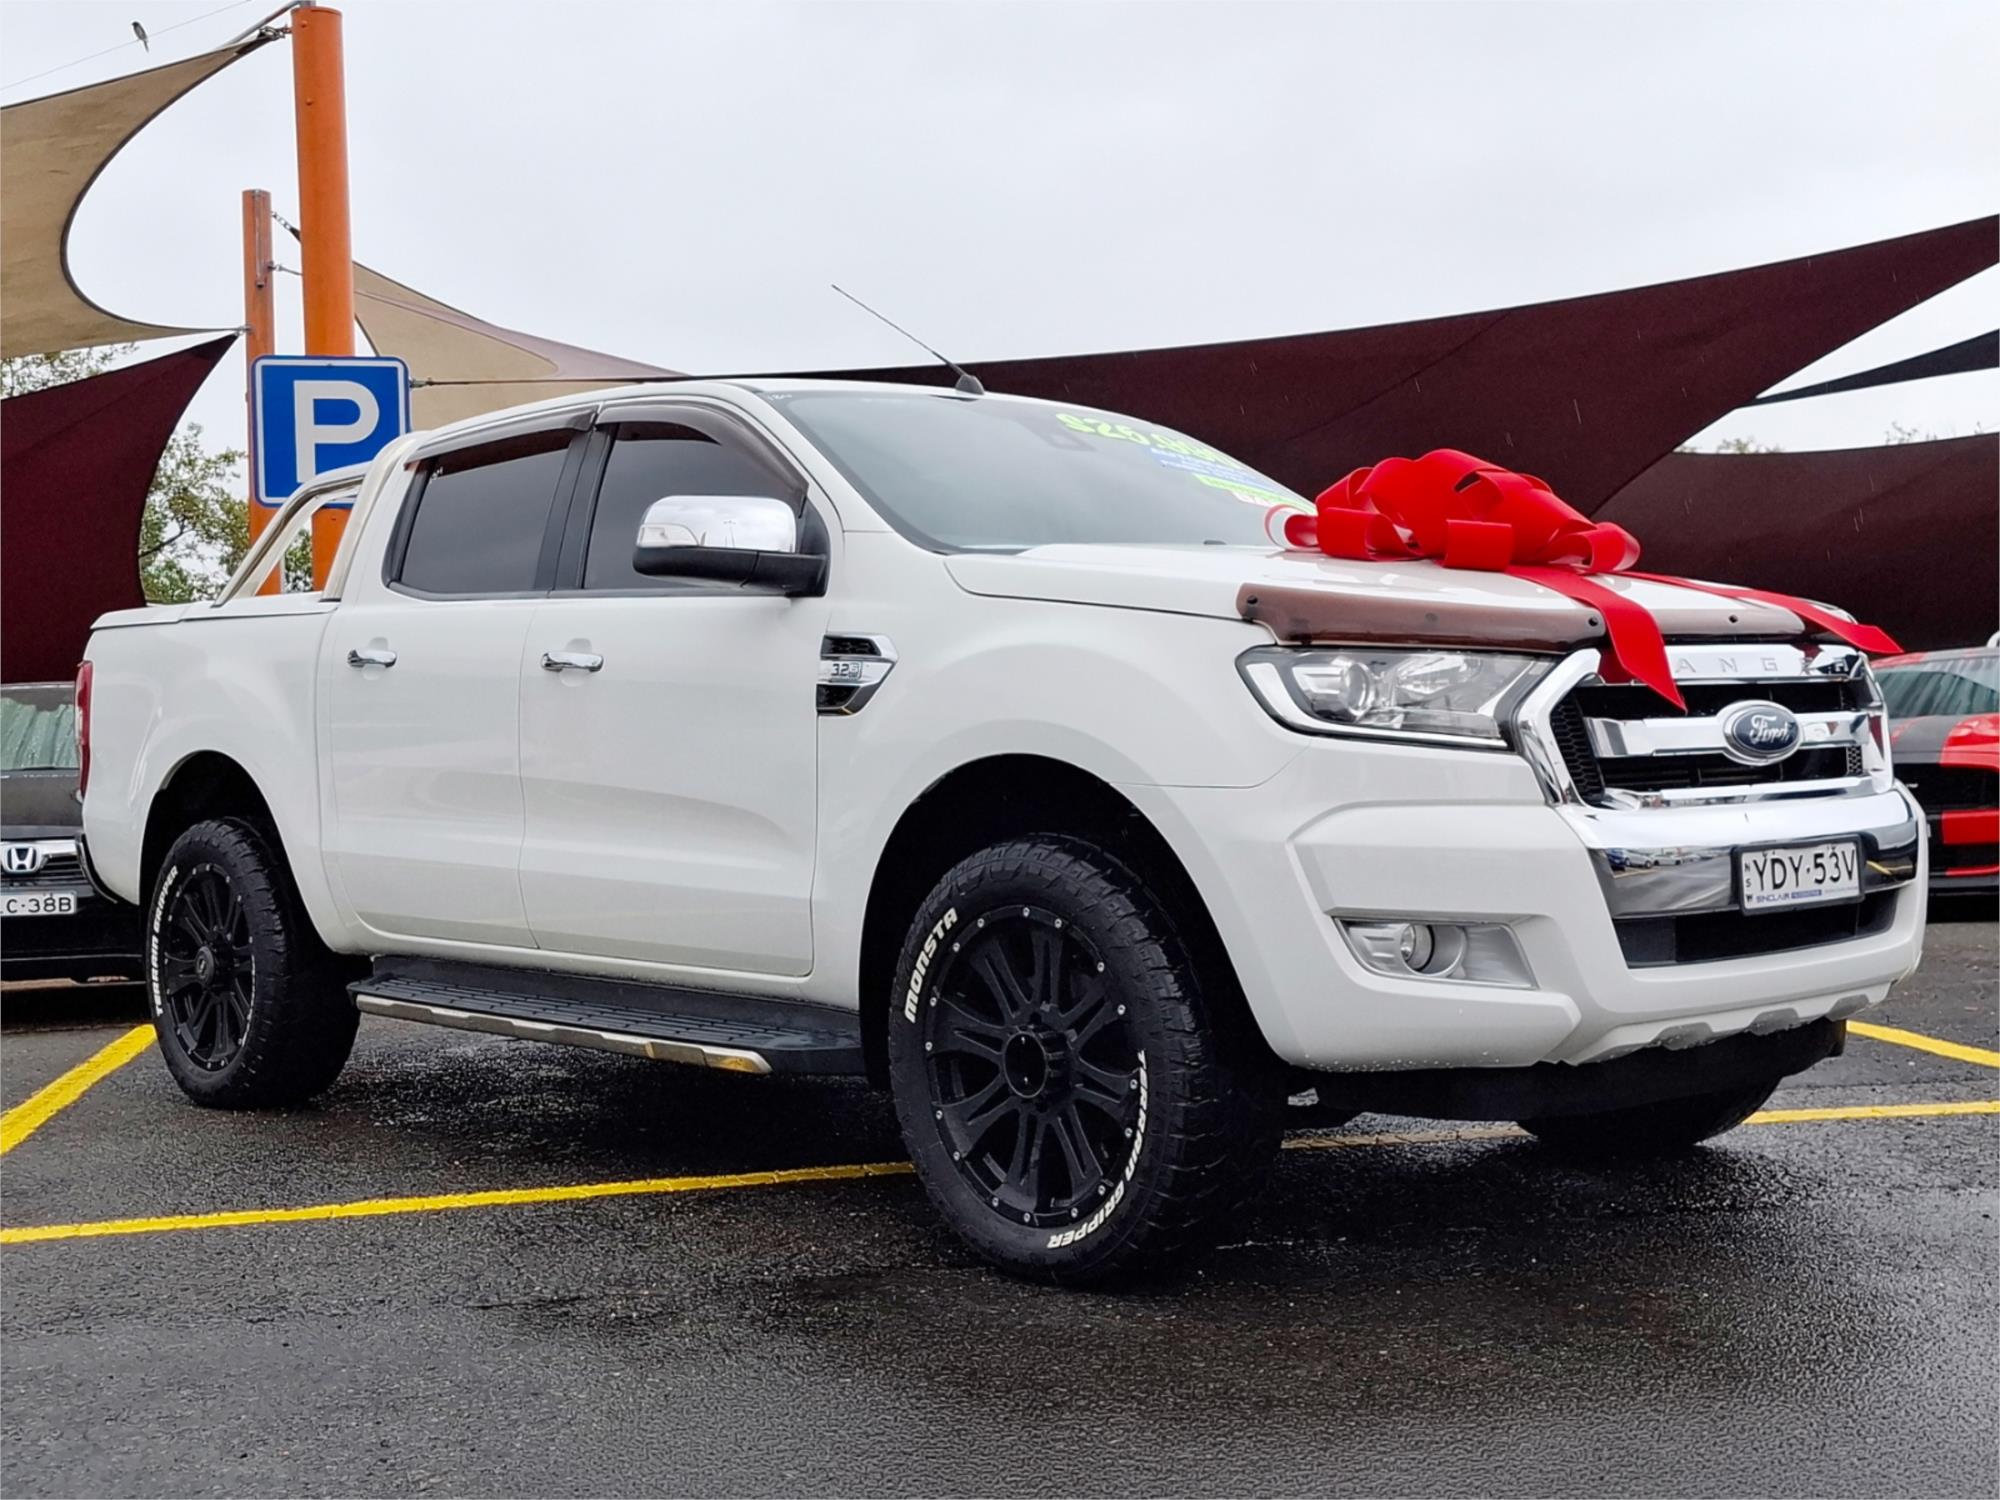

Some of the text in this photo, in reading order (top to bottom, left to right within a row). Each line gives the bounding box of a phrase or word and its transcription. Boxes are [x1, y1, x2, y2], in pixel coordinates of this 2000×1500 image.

[293, 380, 380, 484] P
[1749, 714, 1790, 745] Ford
[153, 864, 179, 933] GRIPPER
[904, 906, 958, 1024] MONSTA
[1046, 1049, 1149, 1249] TERRAIN GRIPPER
